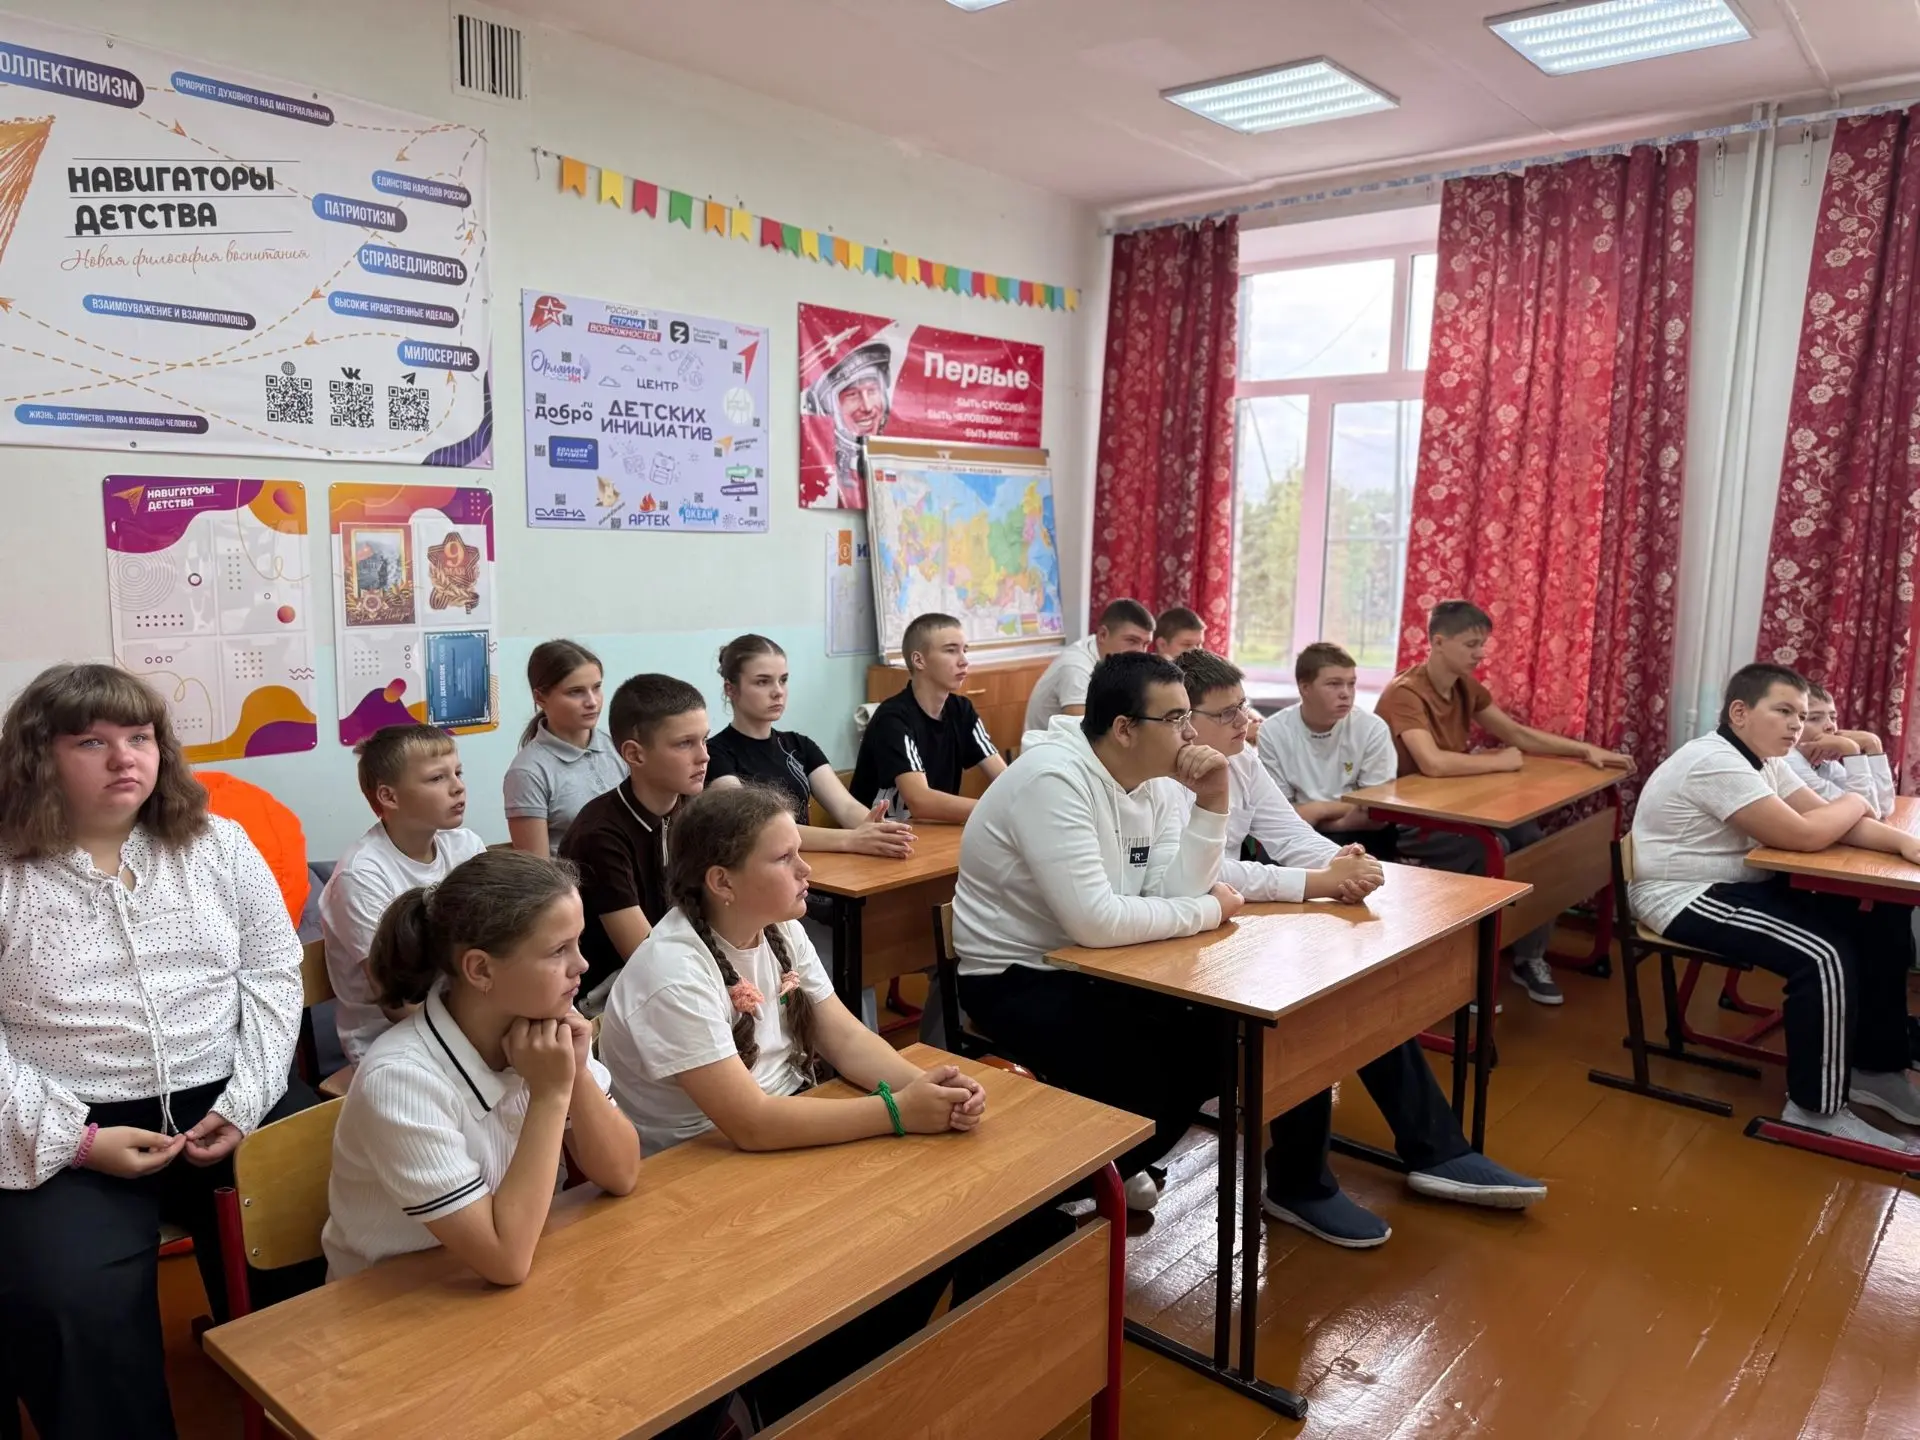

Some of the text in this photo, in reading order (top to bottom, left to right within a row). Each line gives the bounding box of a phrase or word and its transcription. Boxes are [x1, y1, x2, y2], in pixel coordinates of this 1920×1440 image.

[176, 77, 330, 121] ПРИОРИТЕТ ДУХОВНОГО НАД МАТЕРИАЛЬНЫМ
[68, 166, 274, 193] НАВИГАТОРЫ
[377, 176, 468, 202] ЕДИНСТВО НАРОДОВ РОССИИ
[75, 202, 217, 236] ДЕТСТВА
[324, 200, 396, 227] ПАТРИОТИЗМ
[61, 240, 310, 277] Новая философия воспитания
[361, 249, 464, 280] СПРАВЕДЛИВОСТЬ
[92, 298, 248, 327] ВЗАИМОУВАЖЕНИЕ И ВЗАИМОПОМОЩЬ
[335, 297, 454, 323] ВЫСОКИЕ НРАВСТВЕННЫЕ ИДЕАЛЫ
[605, 304, 639, 316] РОССИЯ
[590, 325, 659, 341] ВОЗМОЖНОСТЕЙ
[610, 317, 643, 329] СТРАНА
[404, 345, 473, 367] МИЛОСЕРДИЕ
[924, 350, 1030, 389] Первые
[637, 377, 679, 391] ЦЕНТР
[28, 410, 198, 429] ЖИЗНЬ, ДОСТОИНСТВО, ПРАВА И СВОБОДЫ ЧЕЛОВЕКА
[608, 400, 706, 424] ДЕТСКИХ
[601, 417, 713, 441] ИНИЦИАТИВ
[147, 485, 215, 499] НАВИГАТОРЫ
[148, 499, 194, 512] ДЕТСТВА
[685, 508, 713, 520] ОКЕАН
[629, 514, 671, 527] АРТЕК
[738, 517, 766, 527] Сириус
[444, 541, 465, 567] 9
